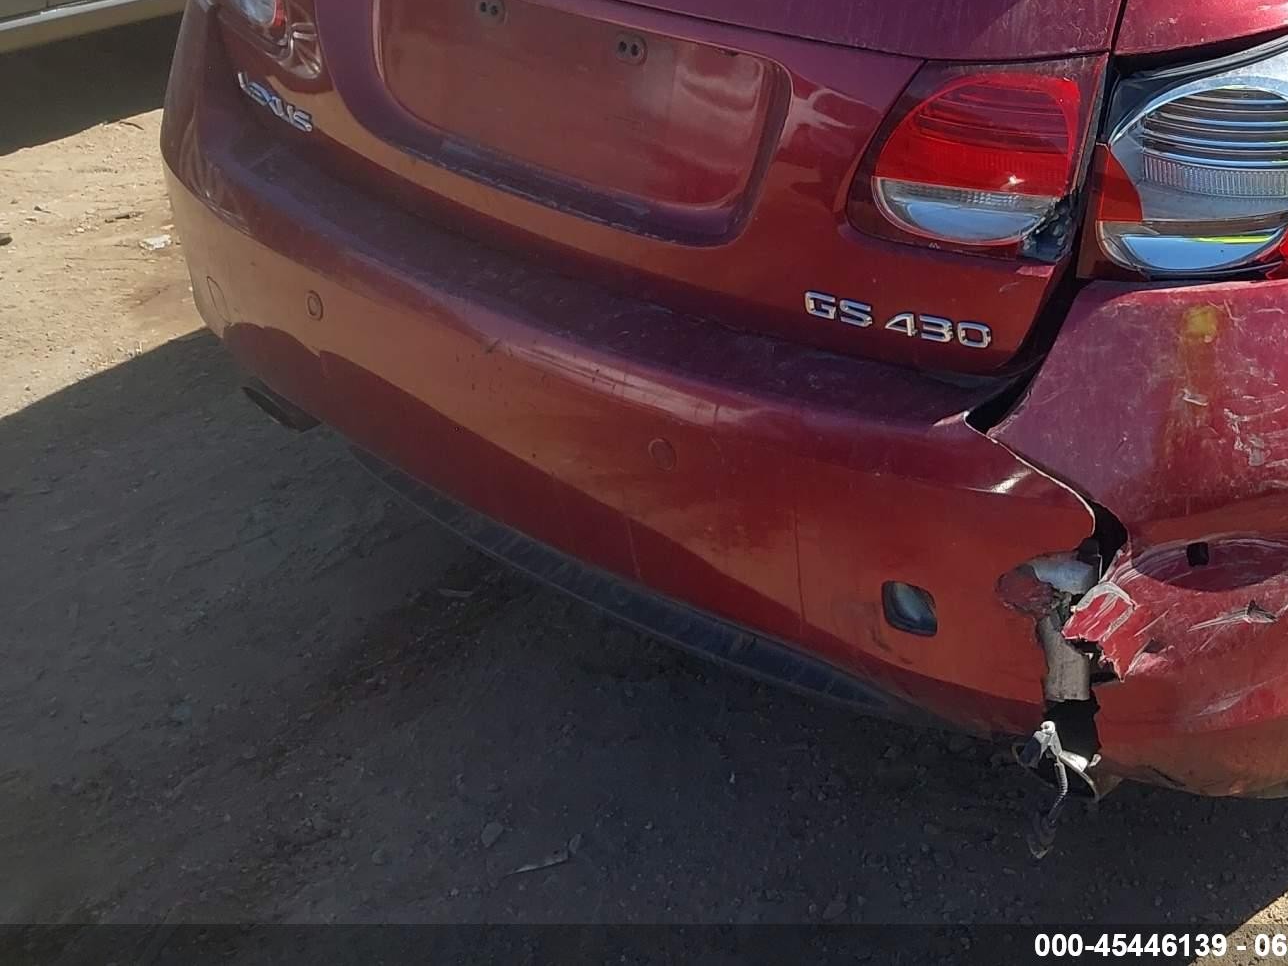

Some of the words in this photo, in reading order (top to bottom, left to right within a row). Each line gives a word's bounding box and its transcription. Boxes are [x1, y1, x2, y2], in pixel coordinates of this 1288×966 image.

[237, 73, 313, 132] LEXUS
[804, 291, 873, 328] GS
[884, 313, 992, 349] 430
